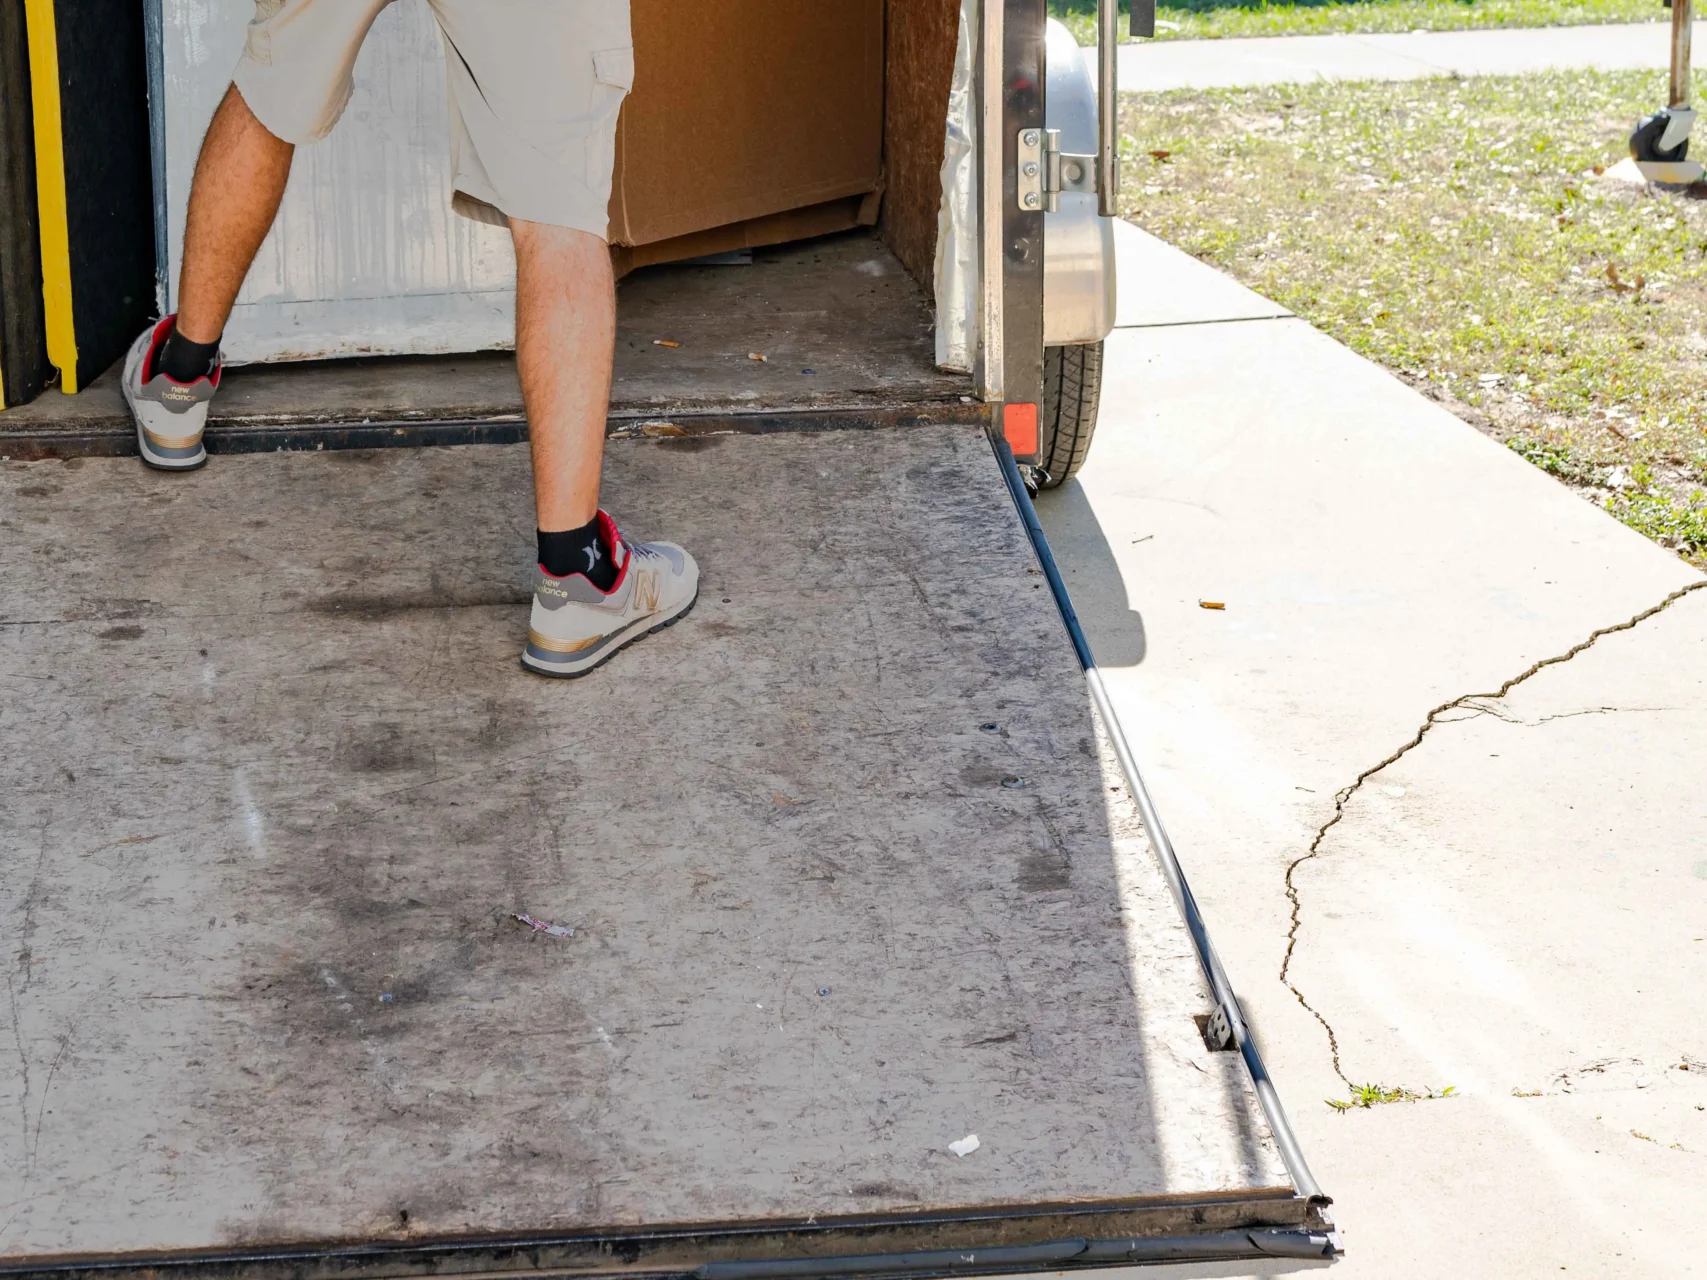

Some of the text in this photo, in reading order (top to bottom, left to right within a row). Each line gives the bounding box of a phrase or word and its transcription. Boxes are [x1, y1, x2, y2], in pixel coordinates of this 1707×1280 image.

[171, 385, 190, 394] new
[161, 391, 197, 402] balance
[542, 578, 561, 588] new
[536, 584, 568, 599] alance
[633, 569, 662, 611] N
